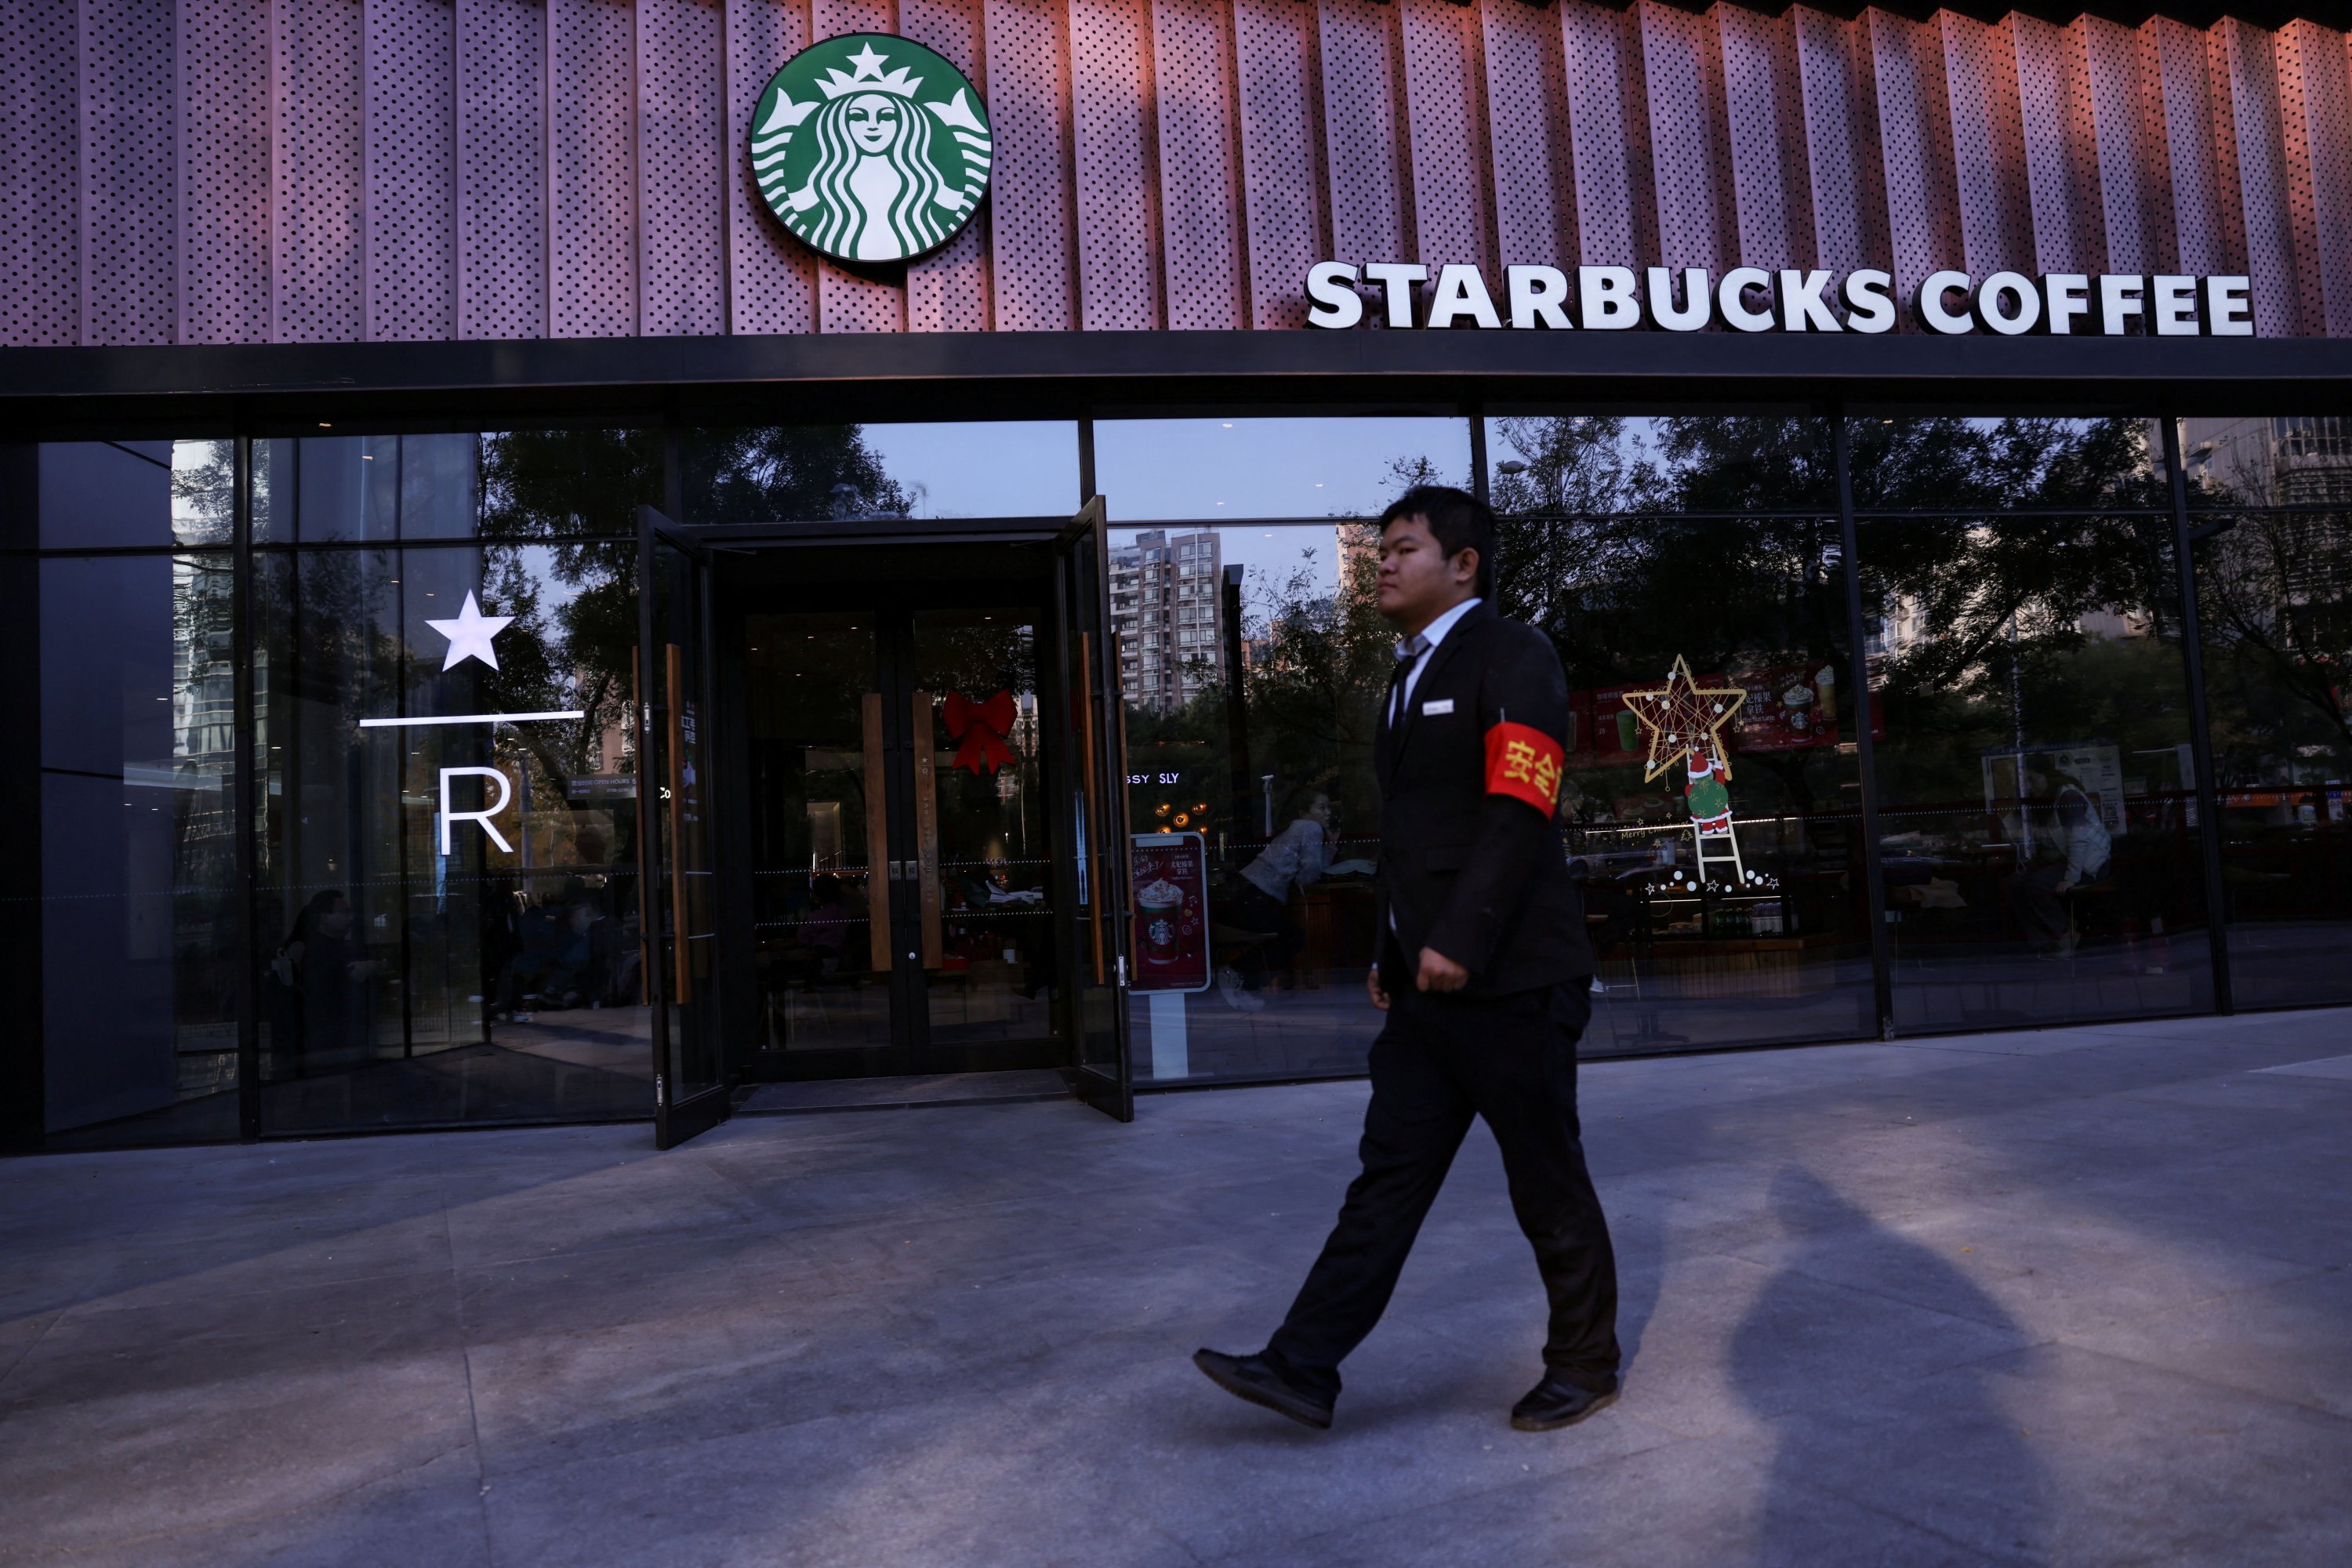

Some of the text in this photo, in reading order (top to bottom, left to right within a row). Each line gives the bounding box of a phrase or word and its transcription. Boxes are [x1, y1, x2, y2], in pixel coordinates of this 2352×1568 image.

[1305, 260, 2254, 336] STARBUCKS COFFEE
[1159, 772, 1179, 784] SLY
[1504, 740, 1563, 804] 安全
[440, 767, 514, 855] R
[1621, 829, 1646, 840] Merry
